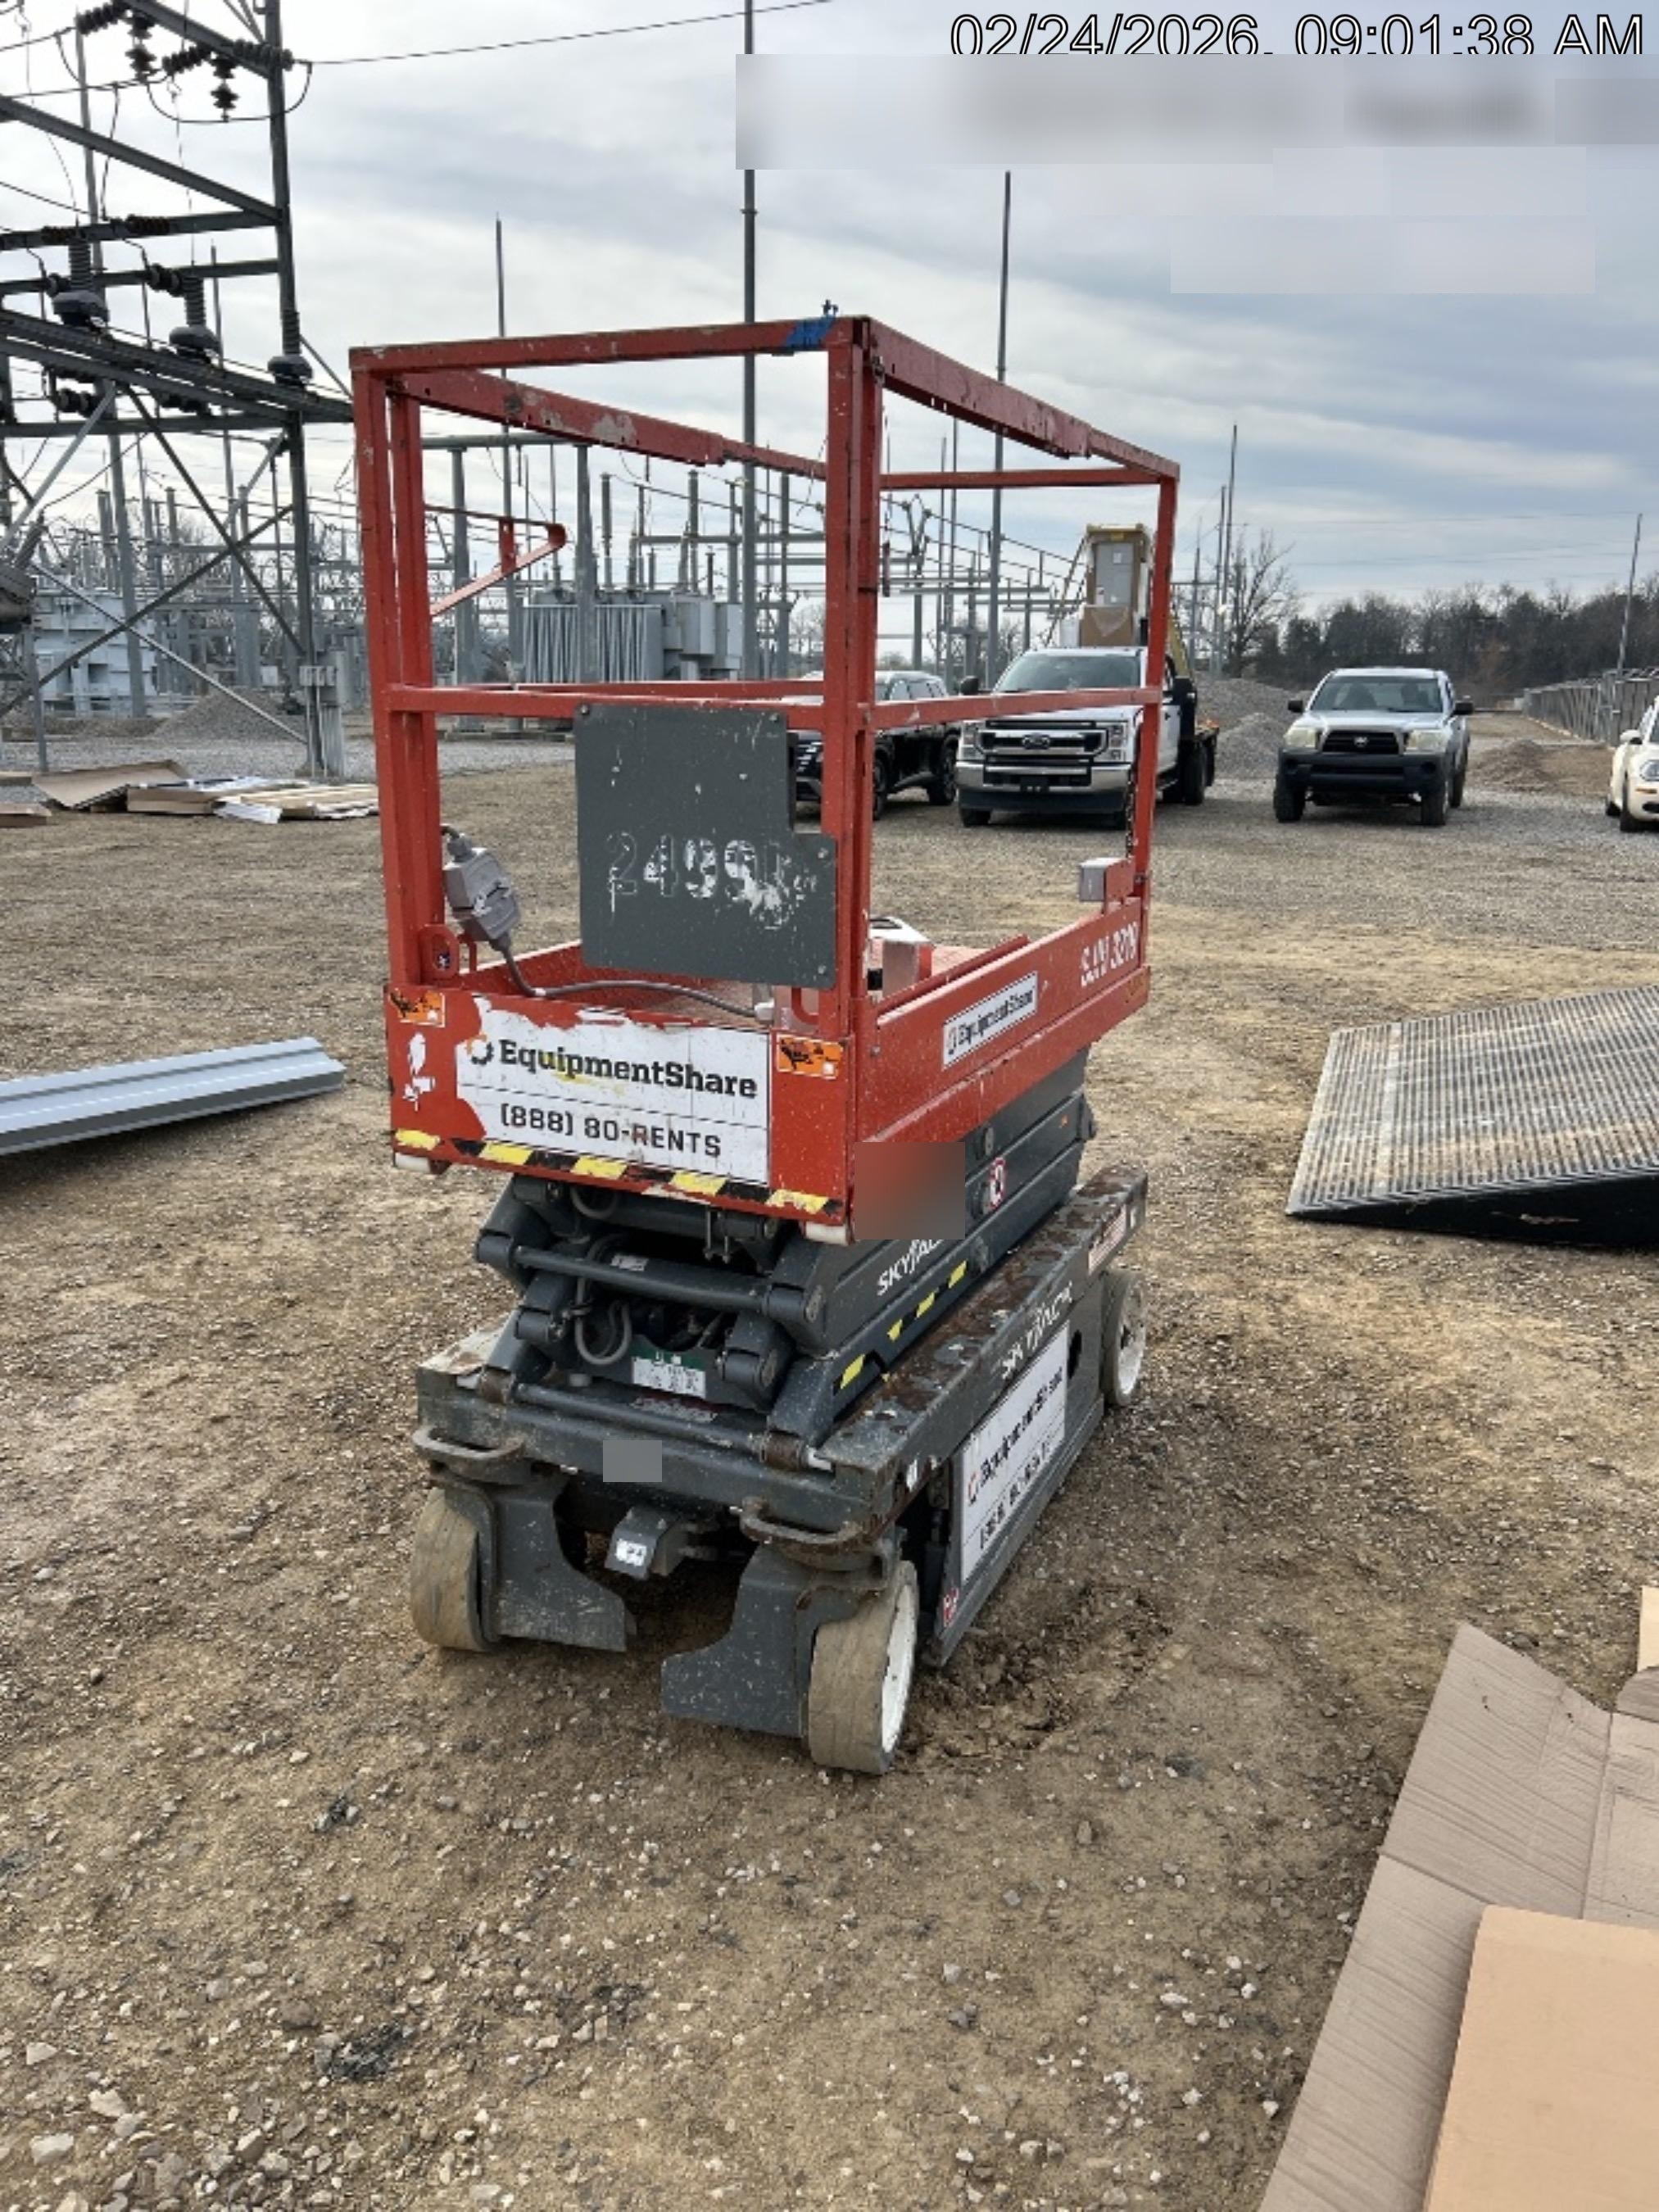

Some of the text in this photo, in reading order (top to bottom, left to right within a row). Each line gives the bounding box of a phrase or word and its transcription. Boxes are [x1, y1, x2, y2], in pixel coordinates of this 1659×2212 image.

[498, 1039, 758, 1099] EquipmentShare
[501, 1103, 722, 1158] (888) 80-RENTS
